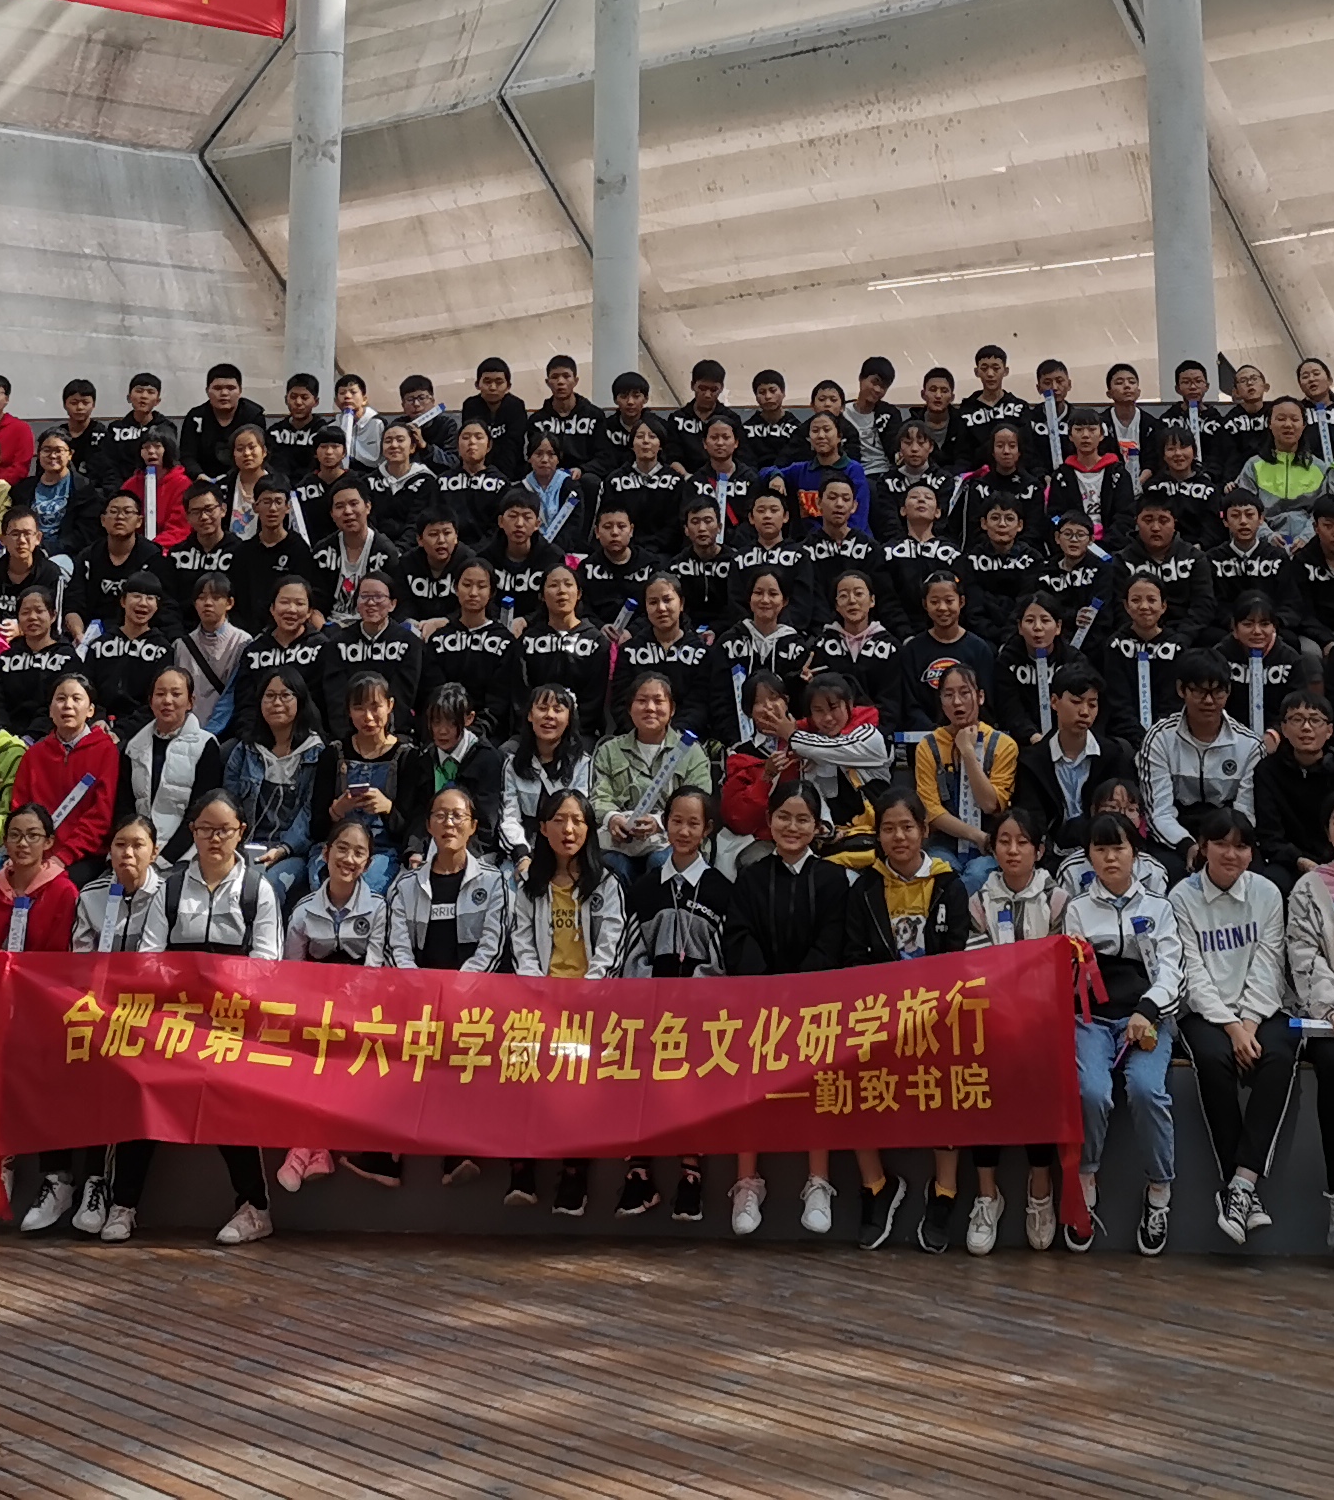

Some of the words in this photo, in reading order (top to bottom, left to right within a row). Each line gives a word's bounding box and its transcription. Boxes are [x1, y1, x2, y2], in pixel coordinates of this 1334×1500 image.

[439, 473, 506, 493] adidas
[91, 636, 166, 661] adidas
[432, 630, 510, 656] adidas
[624, 642, 706, 666] adidas
[61, 976, 991, 1086] 合肥市第三十六中学徽州红色文化研学旅行
